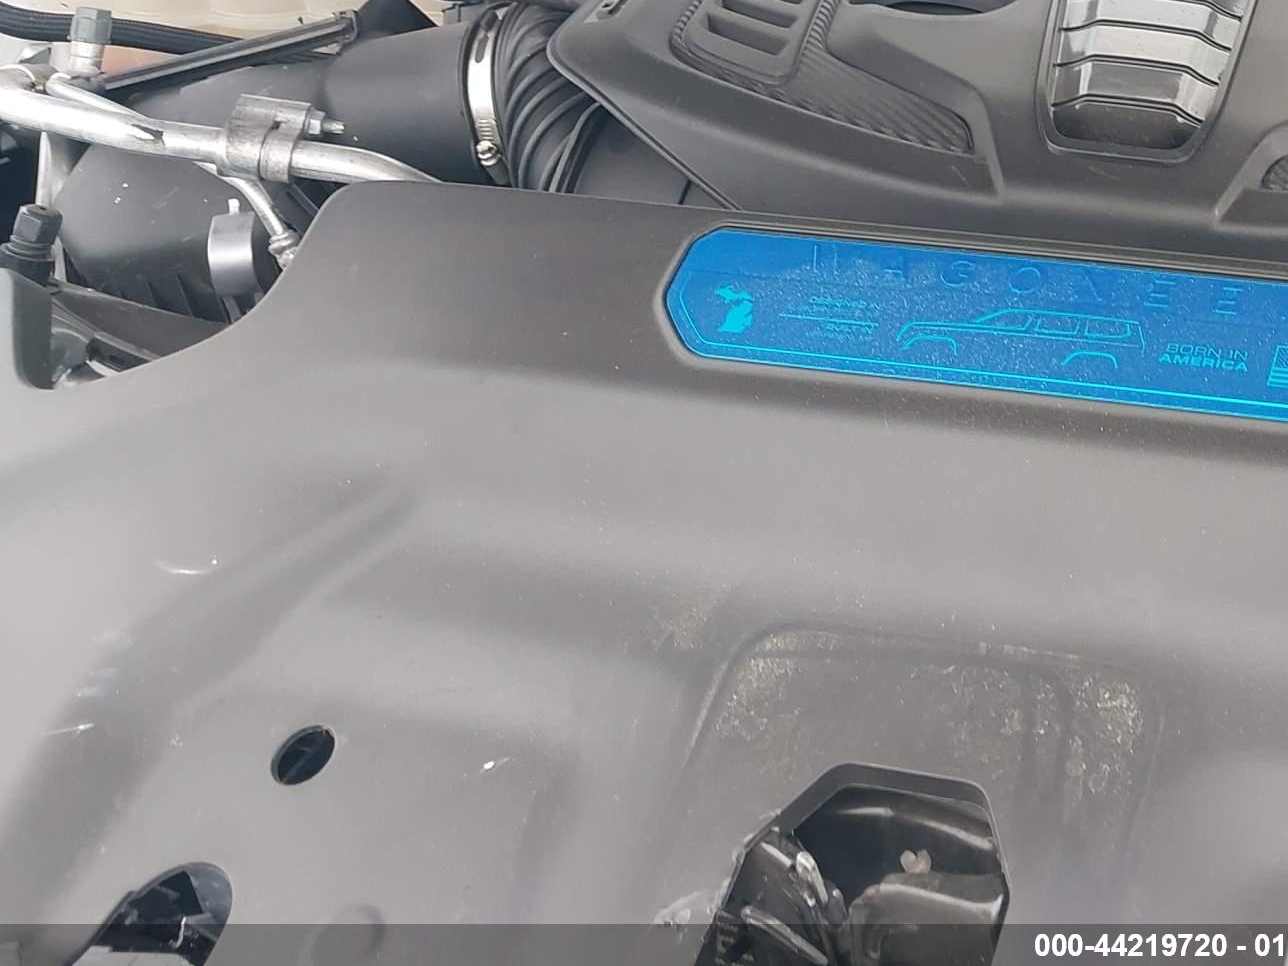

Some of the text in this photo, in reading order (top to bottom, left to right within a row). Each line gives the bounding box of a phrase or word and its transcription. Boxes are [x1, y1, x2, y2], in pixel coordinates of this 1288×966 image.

[1166, 342, 1248, 362] BORN IN
[1159, 353, 1248, 372] AMERICA
